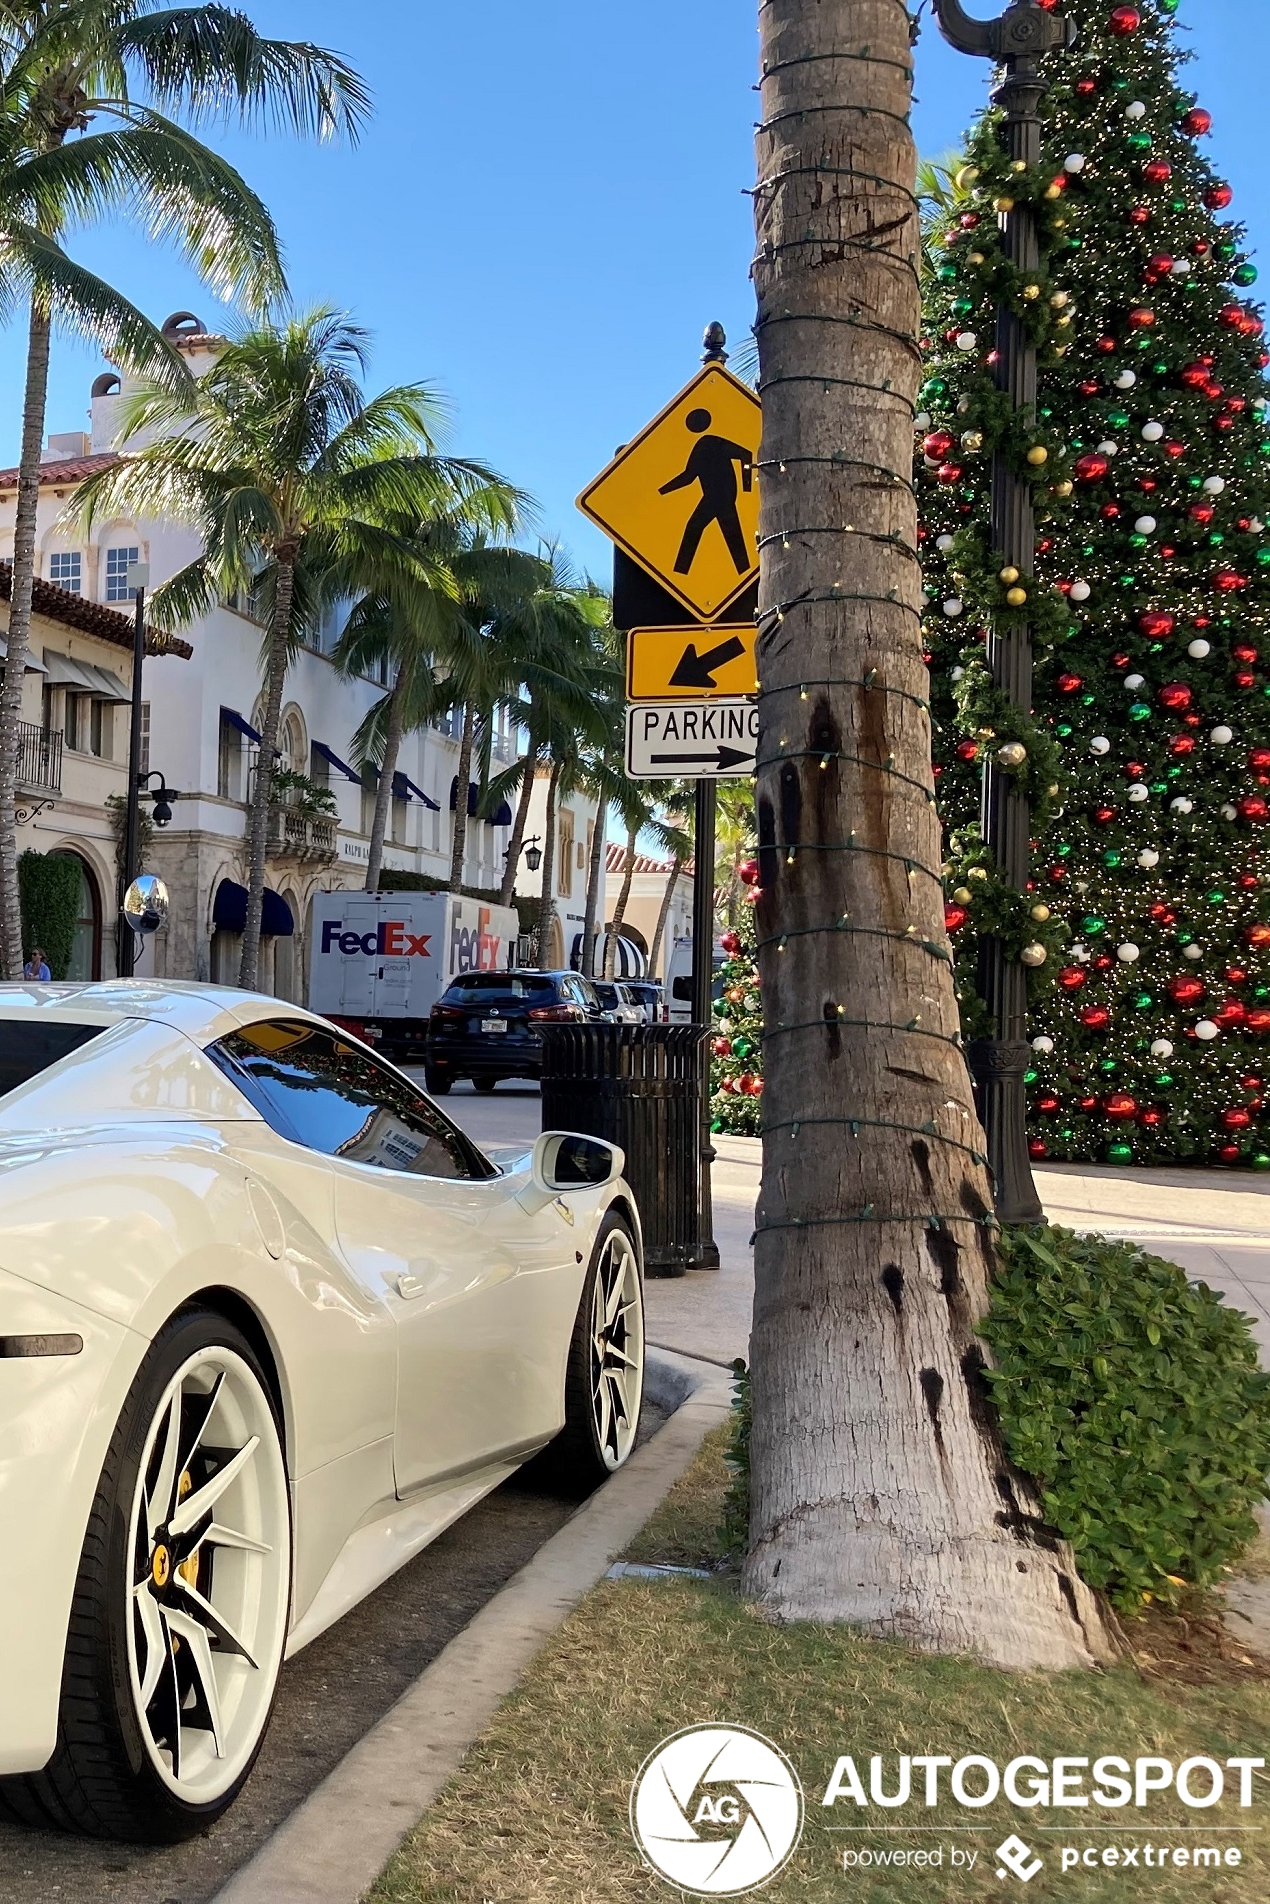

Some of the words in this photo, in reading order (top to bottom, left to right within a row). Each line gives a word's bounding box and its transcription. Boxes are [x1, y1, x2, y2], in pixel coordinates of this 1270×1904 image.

[644, 709, 759, 741] PARKING
[321, 921, 432, 957] FedEx
[450, 901, 500, 974] FedEx
[383, 963, 410, 971] Ground
